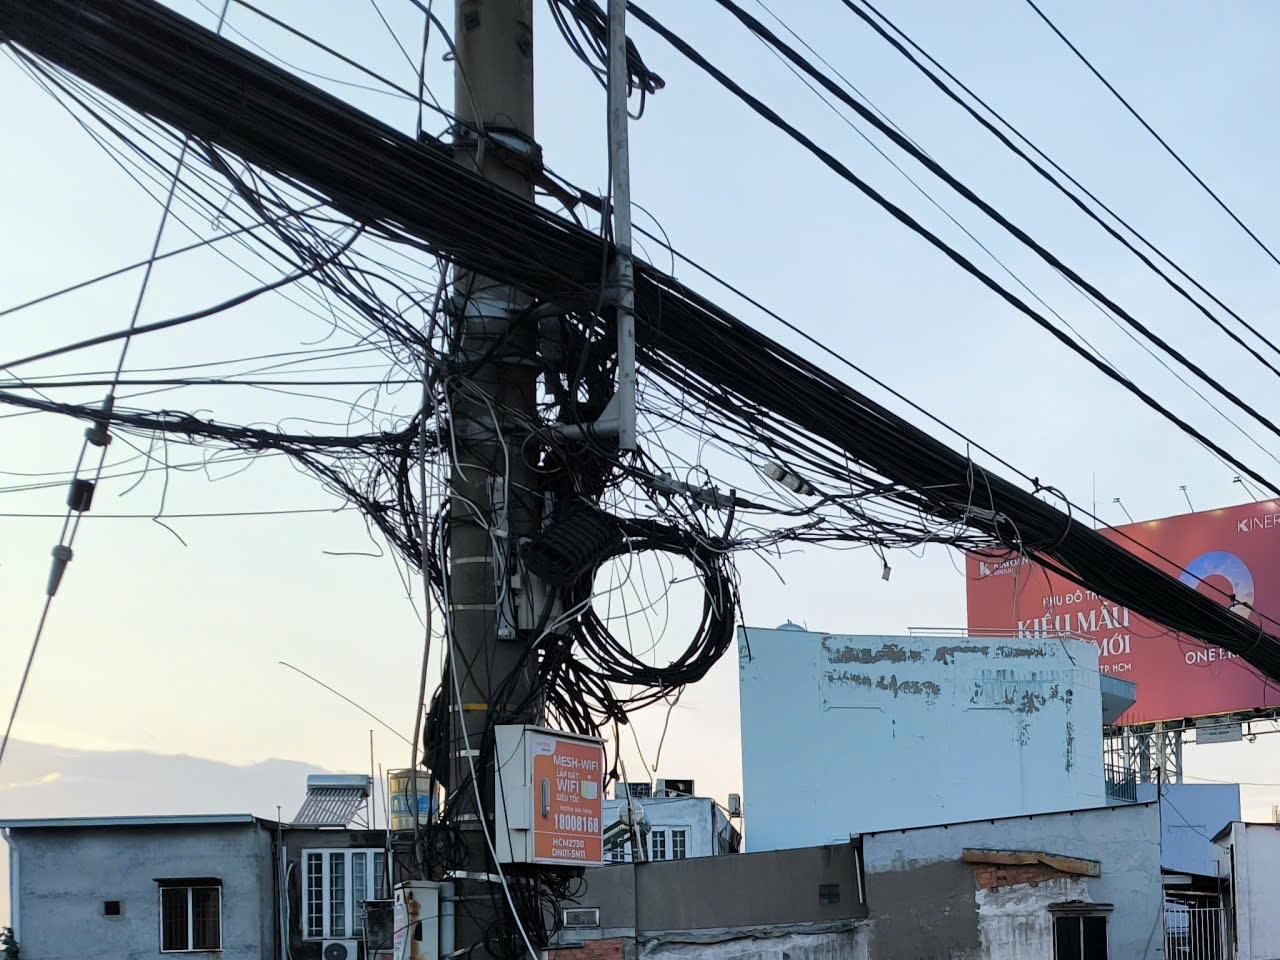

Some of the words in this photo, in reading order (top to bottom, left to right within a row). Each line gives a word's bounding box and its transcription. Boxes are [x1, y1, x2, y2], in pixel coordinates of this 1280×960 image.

[1185, 648, 1216, 665] ONE
[1112, 662, 1132, 673] HCM
[556, 778, 580, 793] WIFI
[554, 814, 599, 833] 18008168
